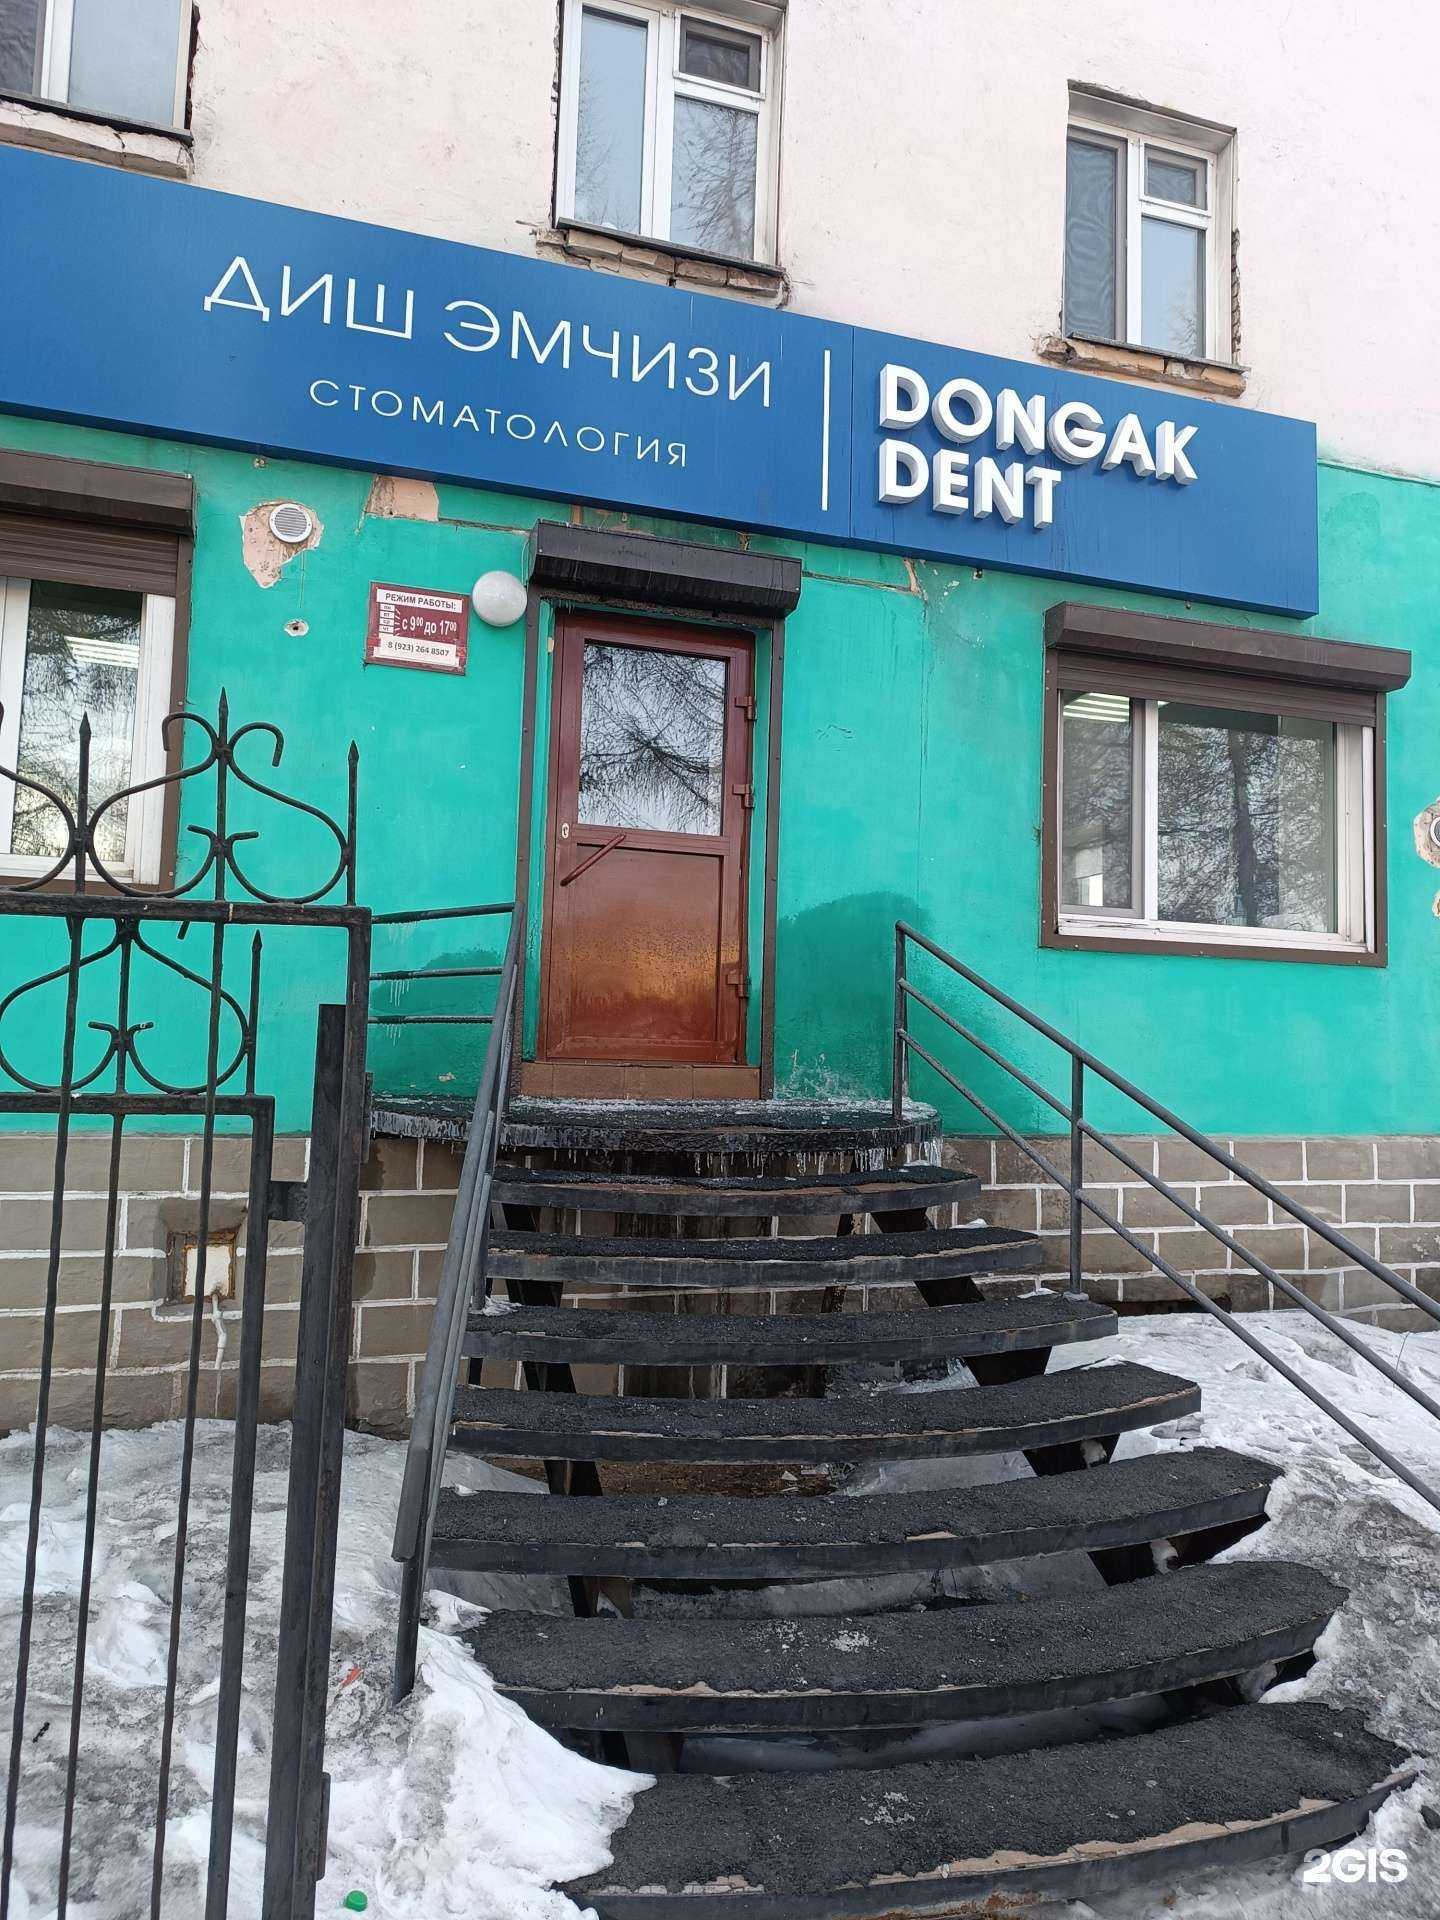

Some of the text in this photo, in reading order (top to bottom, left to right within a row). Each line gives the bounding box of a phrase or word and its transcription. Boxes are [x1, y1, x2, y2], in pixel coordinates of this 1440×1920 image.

[204, 256, 772, 408] ДИШ ЭМЧИЗИ
[309, 379, 688, 468] СТОМАТОЛОГИЯ
[879, 363, 1198, 485] DONGAK
[878, 438, 1062, 529] DENT
[385, 592, 456, 610] РЕЖИМ РАБОТЫ:
[387, 641, 393, 649] 8
[423, 621, 437, 636] до
